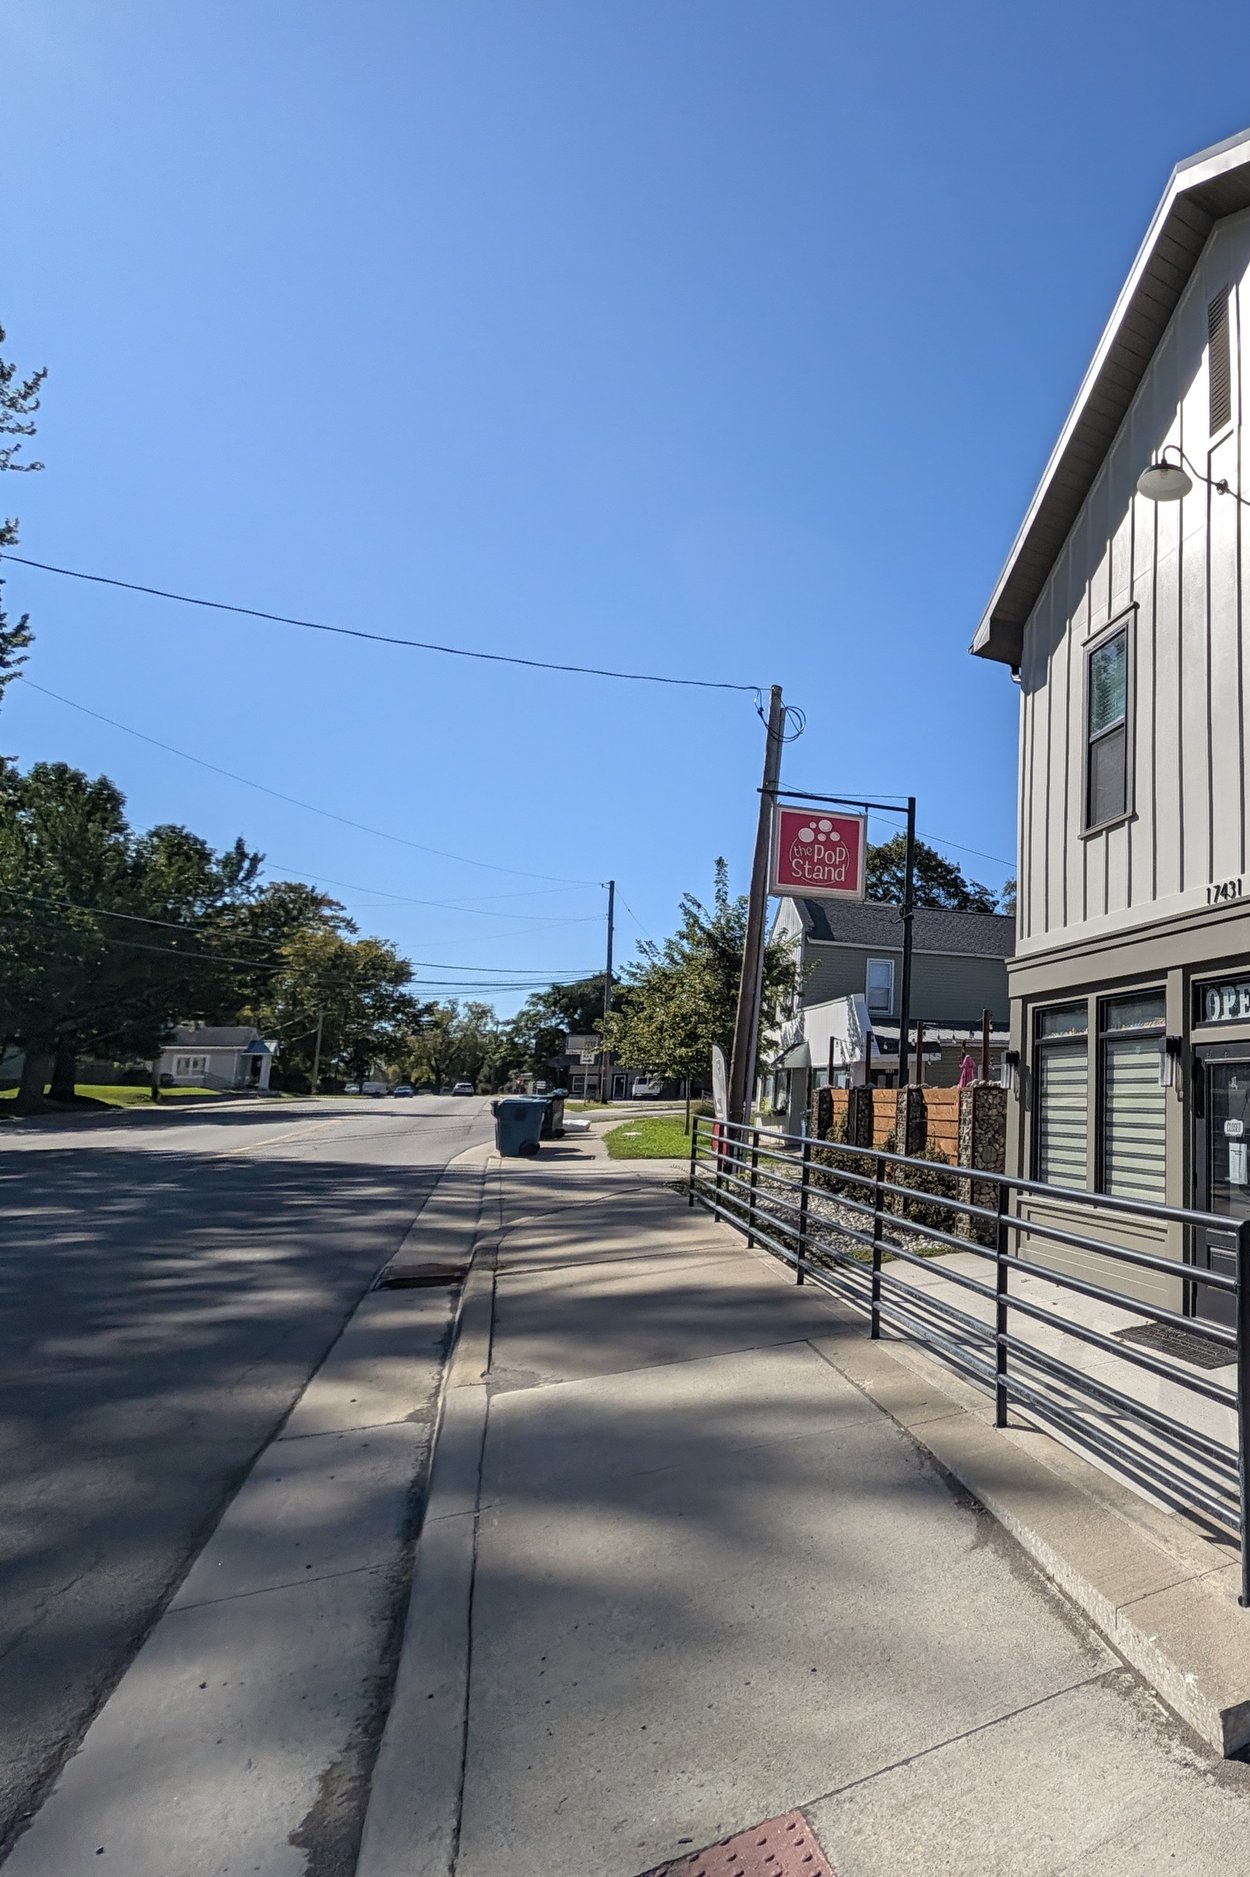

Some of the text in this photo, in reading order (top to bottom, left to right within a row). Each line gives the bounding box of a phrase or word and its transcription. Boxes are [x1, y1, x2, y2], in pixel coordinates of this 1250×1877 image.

[793, 845, 813, 857] the
[791, 858, 846, 882] Stand
[1206, 878, 1242, 905] 17431
